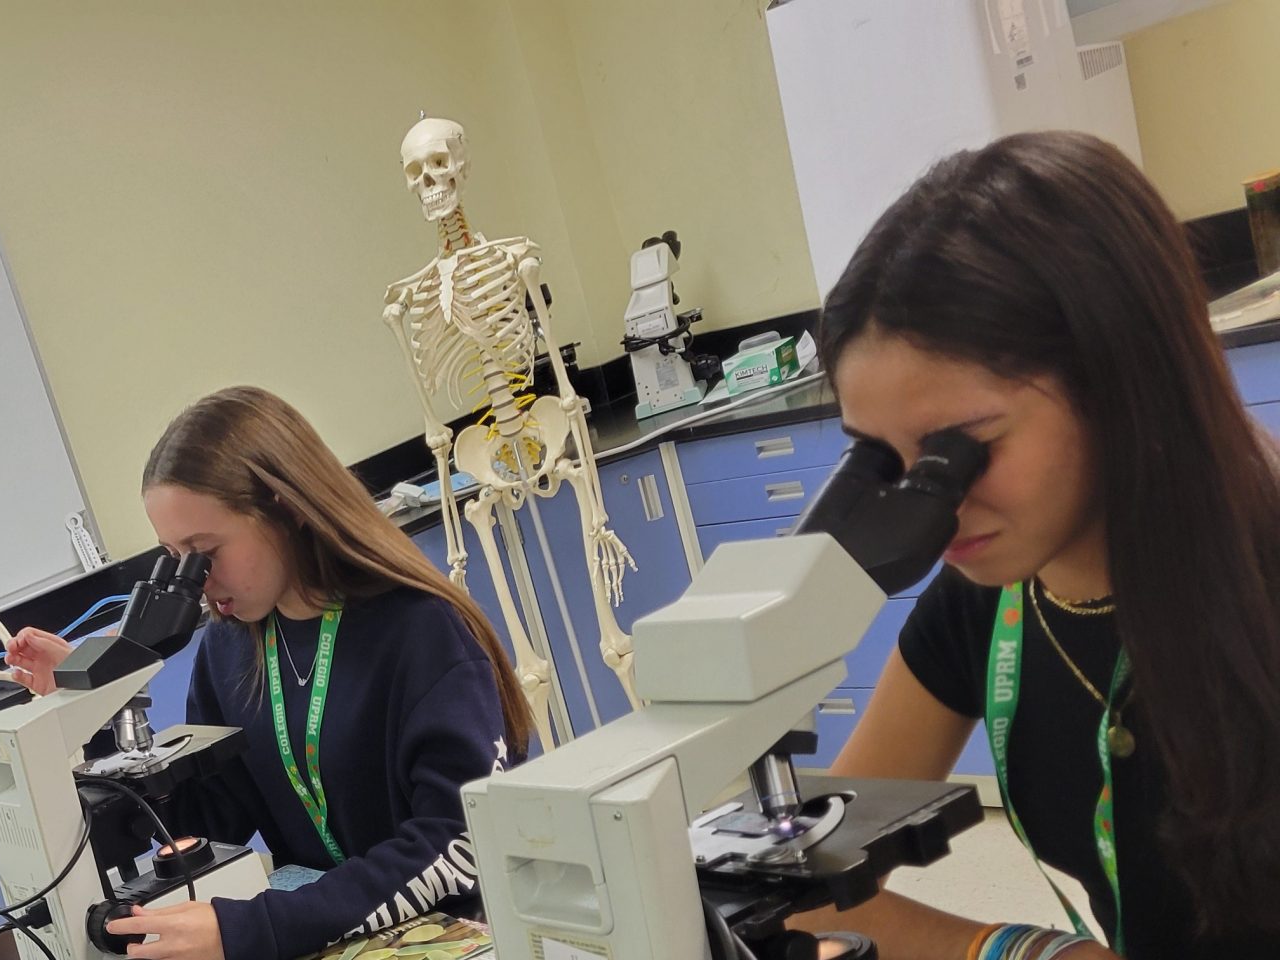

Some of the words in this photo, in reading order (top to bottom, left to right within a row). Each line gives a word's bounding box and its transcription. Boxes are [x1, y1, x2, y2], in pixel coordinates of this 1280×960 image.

[734, 364, 769, 379] KIMTECH
[269, 655, 282, 696] UPRM
[316, 632, 332, 688] COLEGIO
[994, 639, 1018, 704] UPRM
[275, 702, 291, 756] COLEGIO
[308, 696, 323, 736] UPRM
